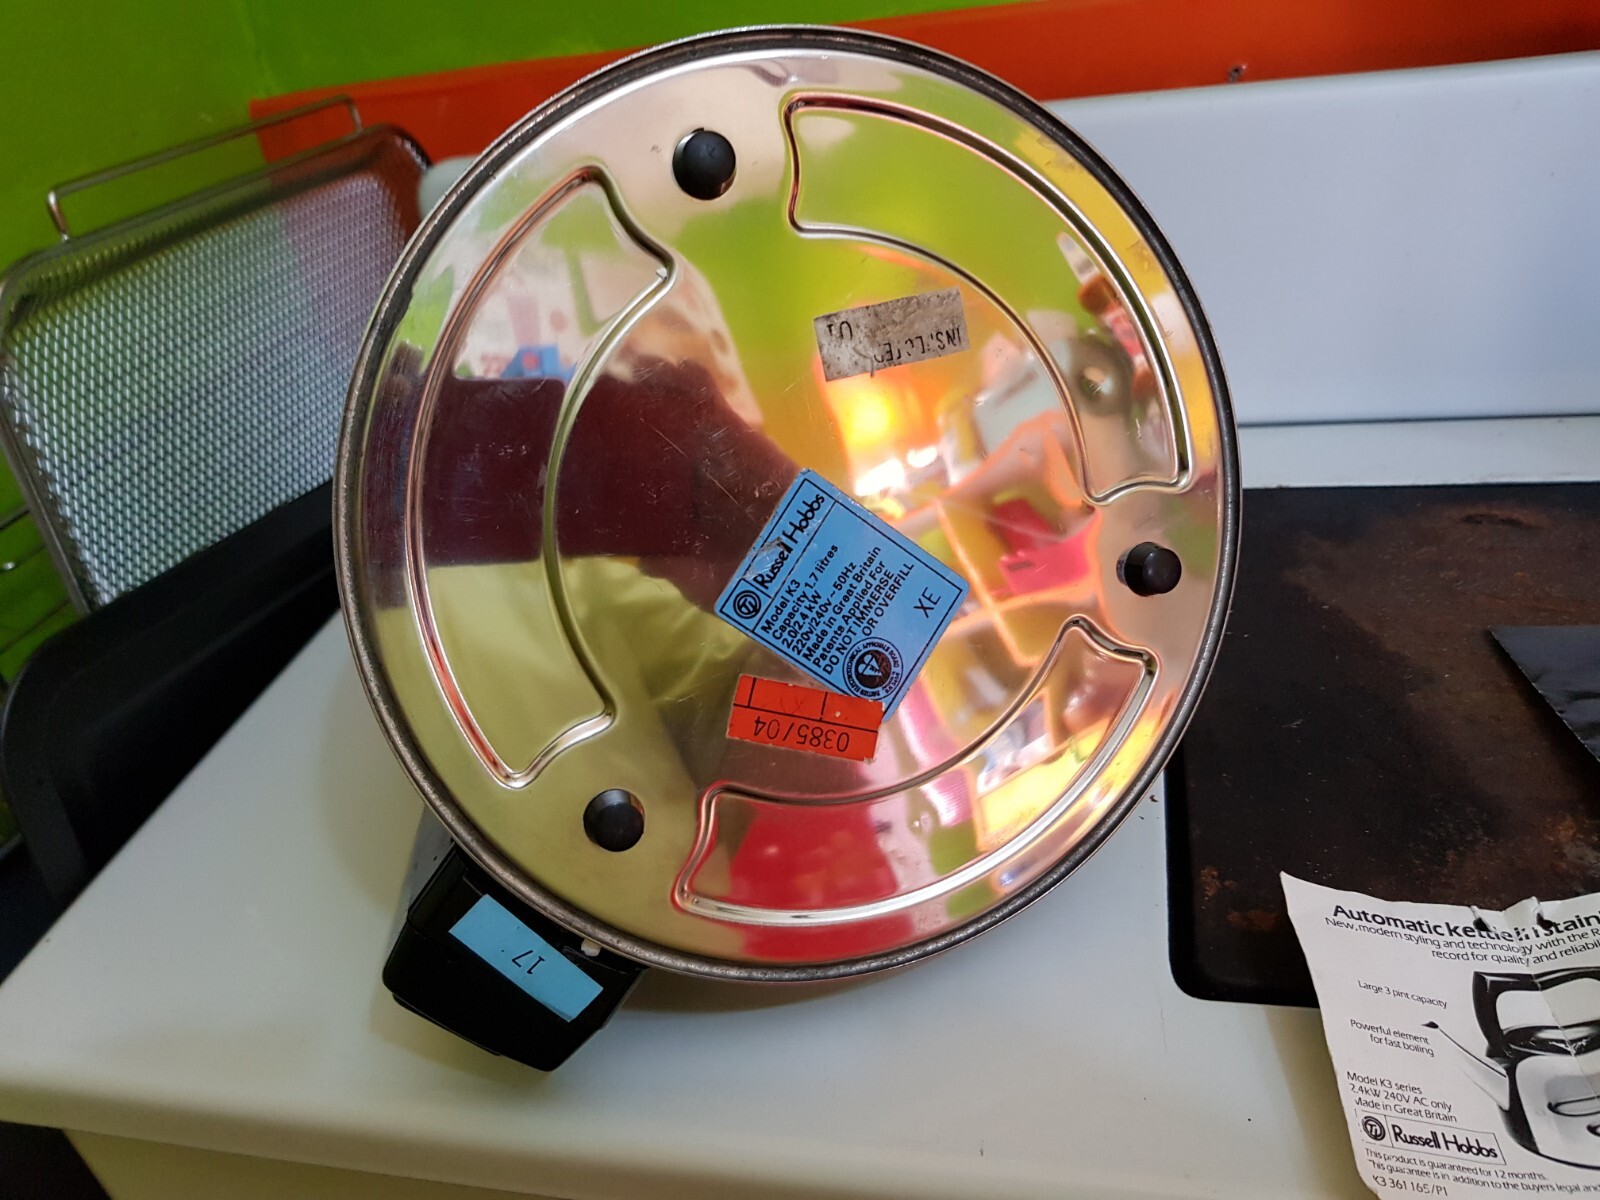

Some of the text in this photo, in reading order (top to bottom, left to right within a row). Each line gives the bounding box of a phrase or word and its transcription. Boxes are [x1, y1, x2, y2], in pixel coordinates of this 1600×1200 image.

[753, 539, 793, 589] Russell
[782, 492, 825, 544] Hobbs
[760, 578, 800, 633] Model K3
[771, 543, 838, 641] Capacity 1.7 litres
[802, 544, 880, 661] Made in Great Britain
[861, 560, 913, 637] OR OVERFILL
[913, 586, 940, 618] XE
[781, 589, 822, 648] 2.0/2.4 kW
[812, 560, 885, 667] Patents Applied For
[822, 569, 893, 674] DO NOT IMMERSE
[753, 715, 850, 752] 0385/04
[1333, 905, 1445, 936] Automatic
[1543, 911, 1600, 937] stain
[1358, 924, 1402, 940] modern
[1403, 933, 1441, 949] styling
[1443, 939, 1465, 949] and
[1467, 940, 1533, 957] technology
[1536, 936, 1566, 951] with
[1566, 933, 1590, 943] the
[511, 949, 546, 975] 17
[1431, 949, 1470, 961] record
[1470, 950, 1489, 961] for
[1490, 953, 1530, 967] quality
[1533, 950, 1558, 964] and
[1358, 980, 1383, 994] Large
[1392, 989, 1411, 1000] pint
[1411, 993, 1447, 1009] capacity
[1350, 1019, 1430, 1045] Powerful element
[1369, 1033, 1435, 1058] for fast boiling
[1346, 1071, 1423, 1095] Model K3 series
[1350, 1083, 1452, 1113] 2.4kW 240V AC only
[1354, 1097, 1458, 1124] Made in Great Britain
[1392, 1124, 1441, 1149] Russell
[1442, 1133, 1498, 1158] Hobbs
[1365, 1147, 1383, 1160] This
[1383, 1152, 1418, 1166] product
[1427, 1160, 1479, 1176] guaranteed
[1479, 1167, 1492, 1177] for
[1386, 1164, 1432, 1178] guarantee
[1440, 1172, 1451, 1181] in
[1452, 1174, 1490, 1188] addition
[1490, 1180, 1502, 1189] to
[1502, 1180, 1520, 1190] the
[1520, 1182, 1556, 1194] buyers
[1556, 1183, 1581, 1195] legal
[1583, 1184, 1600, 1192] an
[1388, 1177, 1407, 1191] 361
